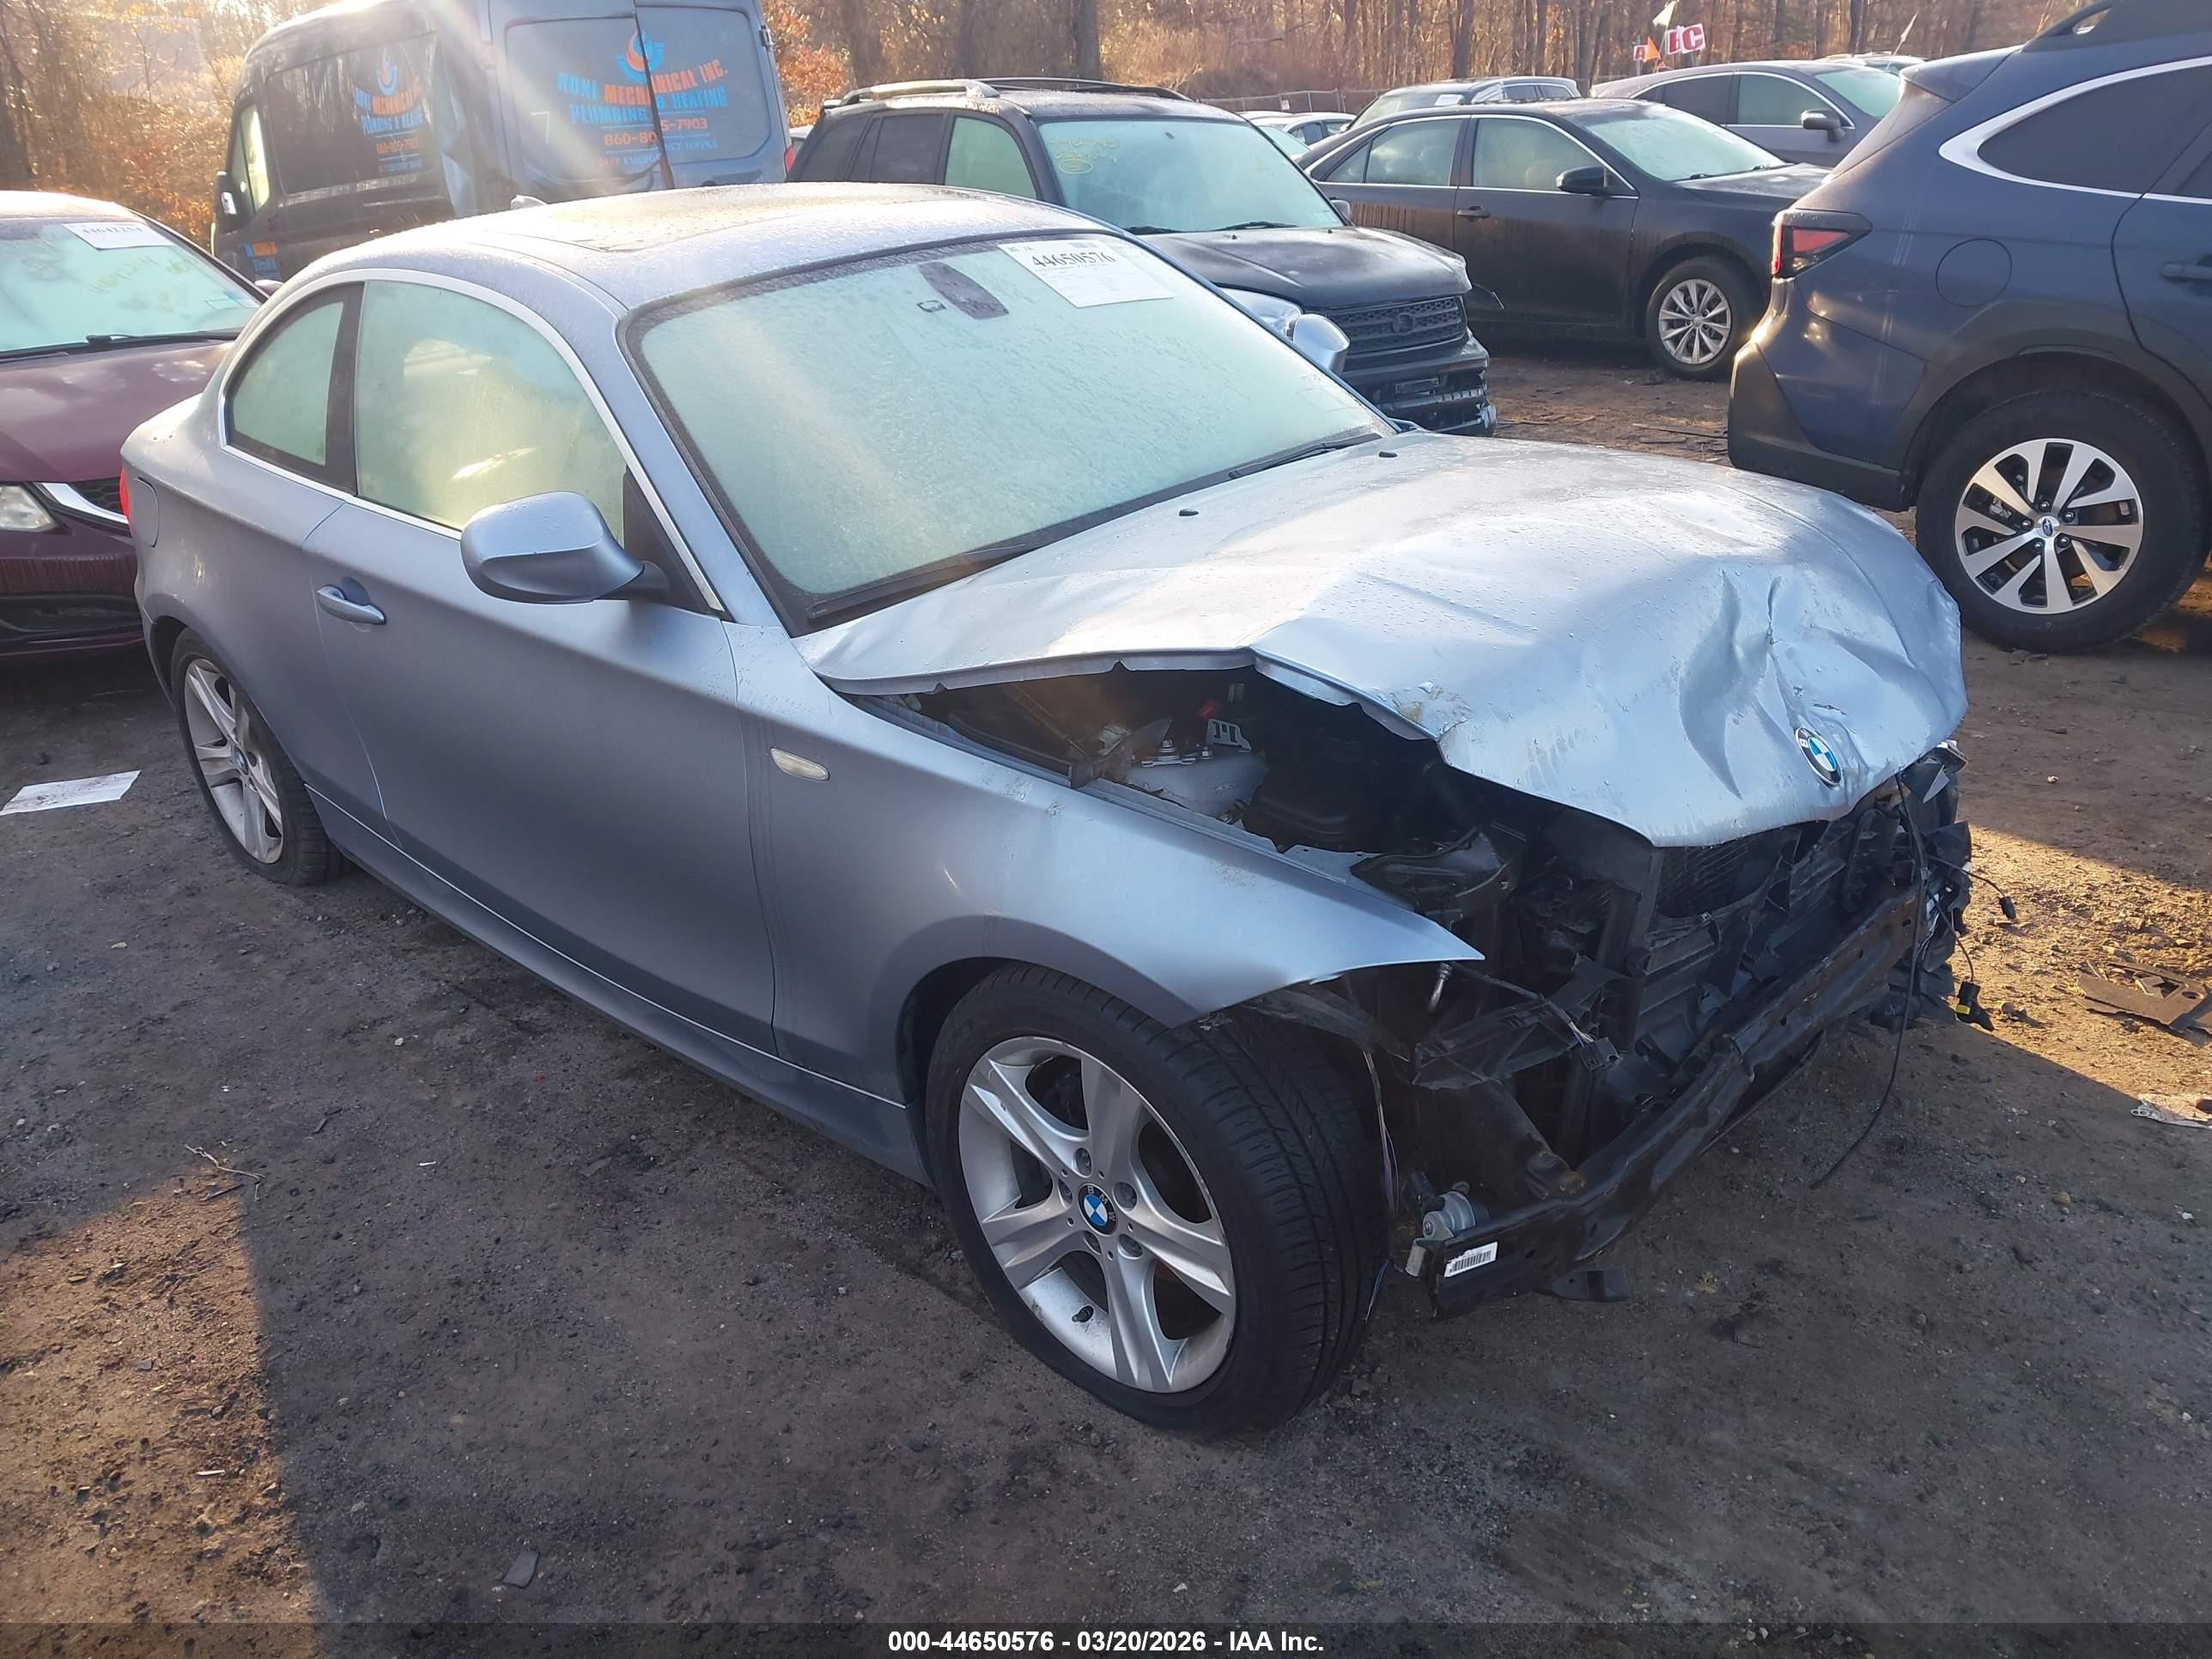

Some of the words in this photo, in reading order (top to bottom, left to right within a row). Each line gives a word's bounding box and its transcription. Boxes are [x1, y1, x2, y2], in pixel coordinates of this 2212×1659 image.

[698, 58, 728, 83] INC.
[1032, 252, 1116, 267] 44650576
[1087, 1186, 1115, 1221] BMW
